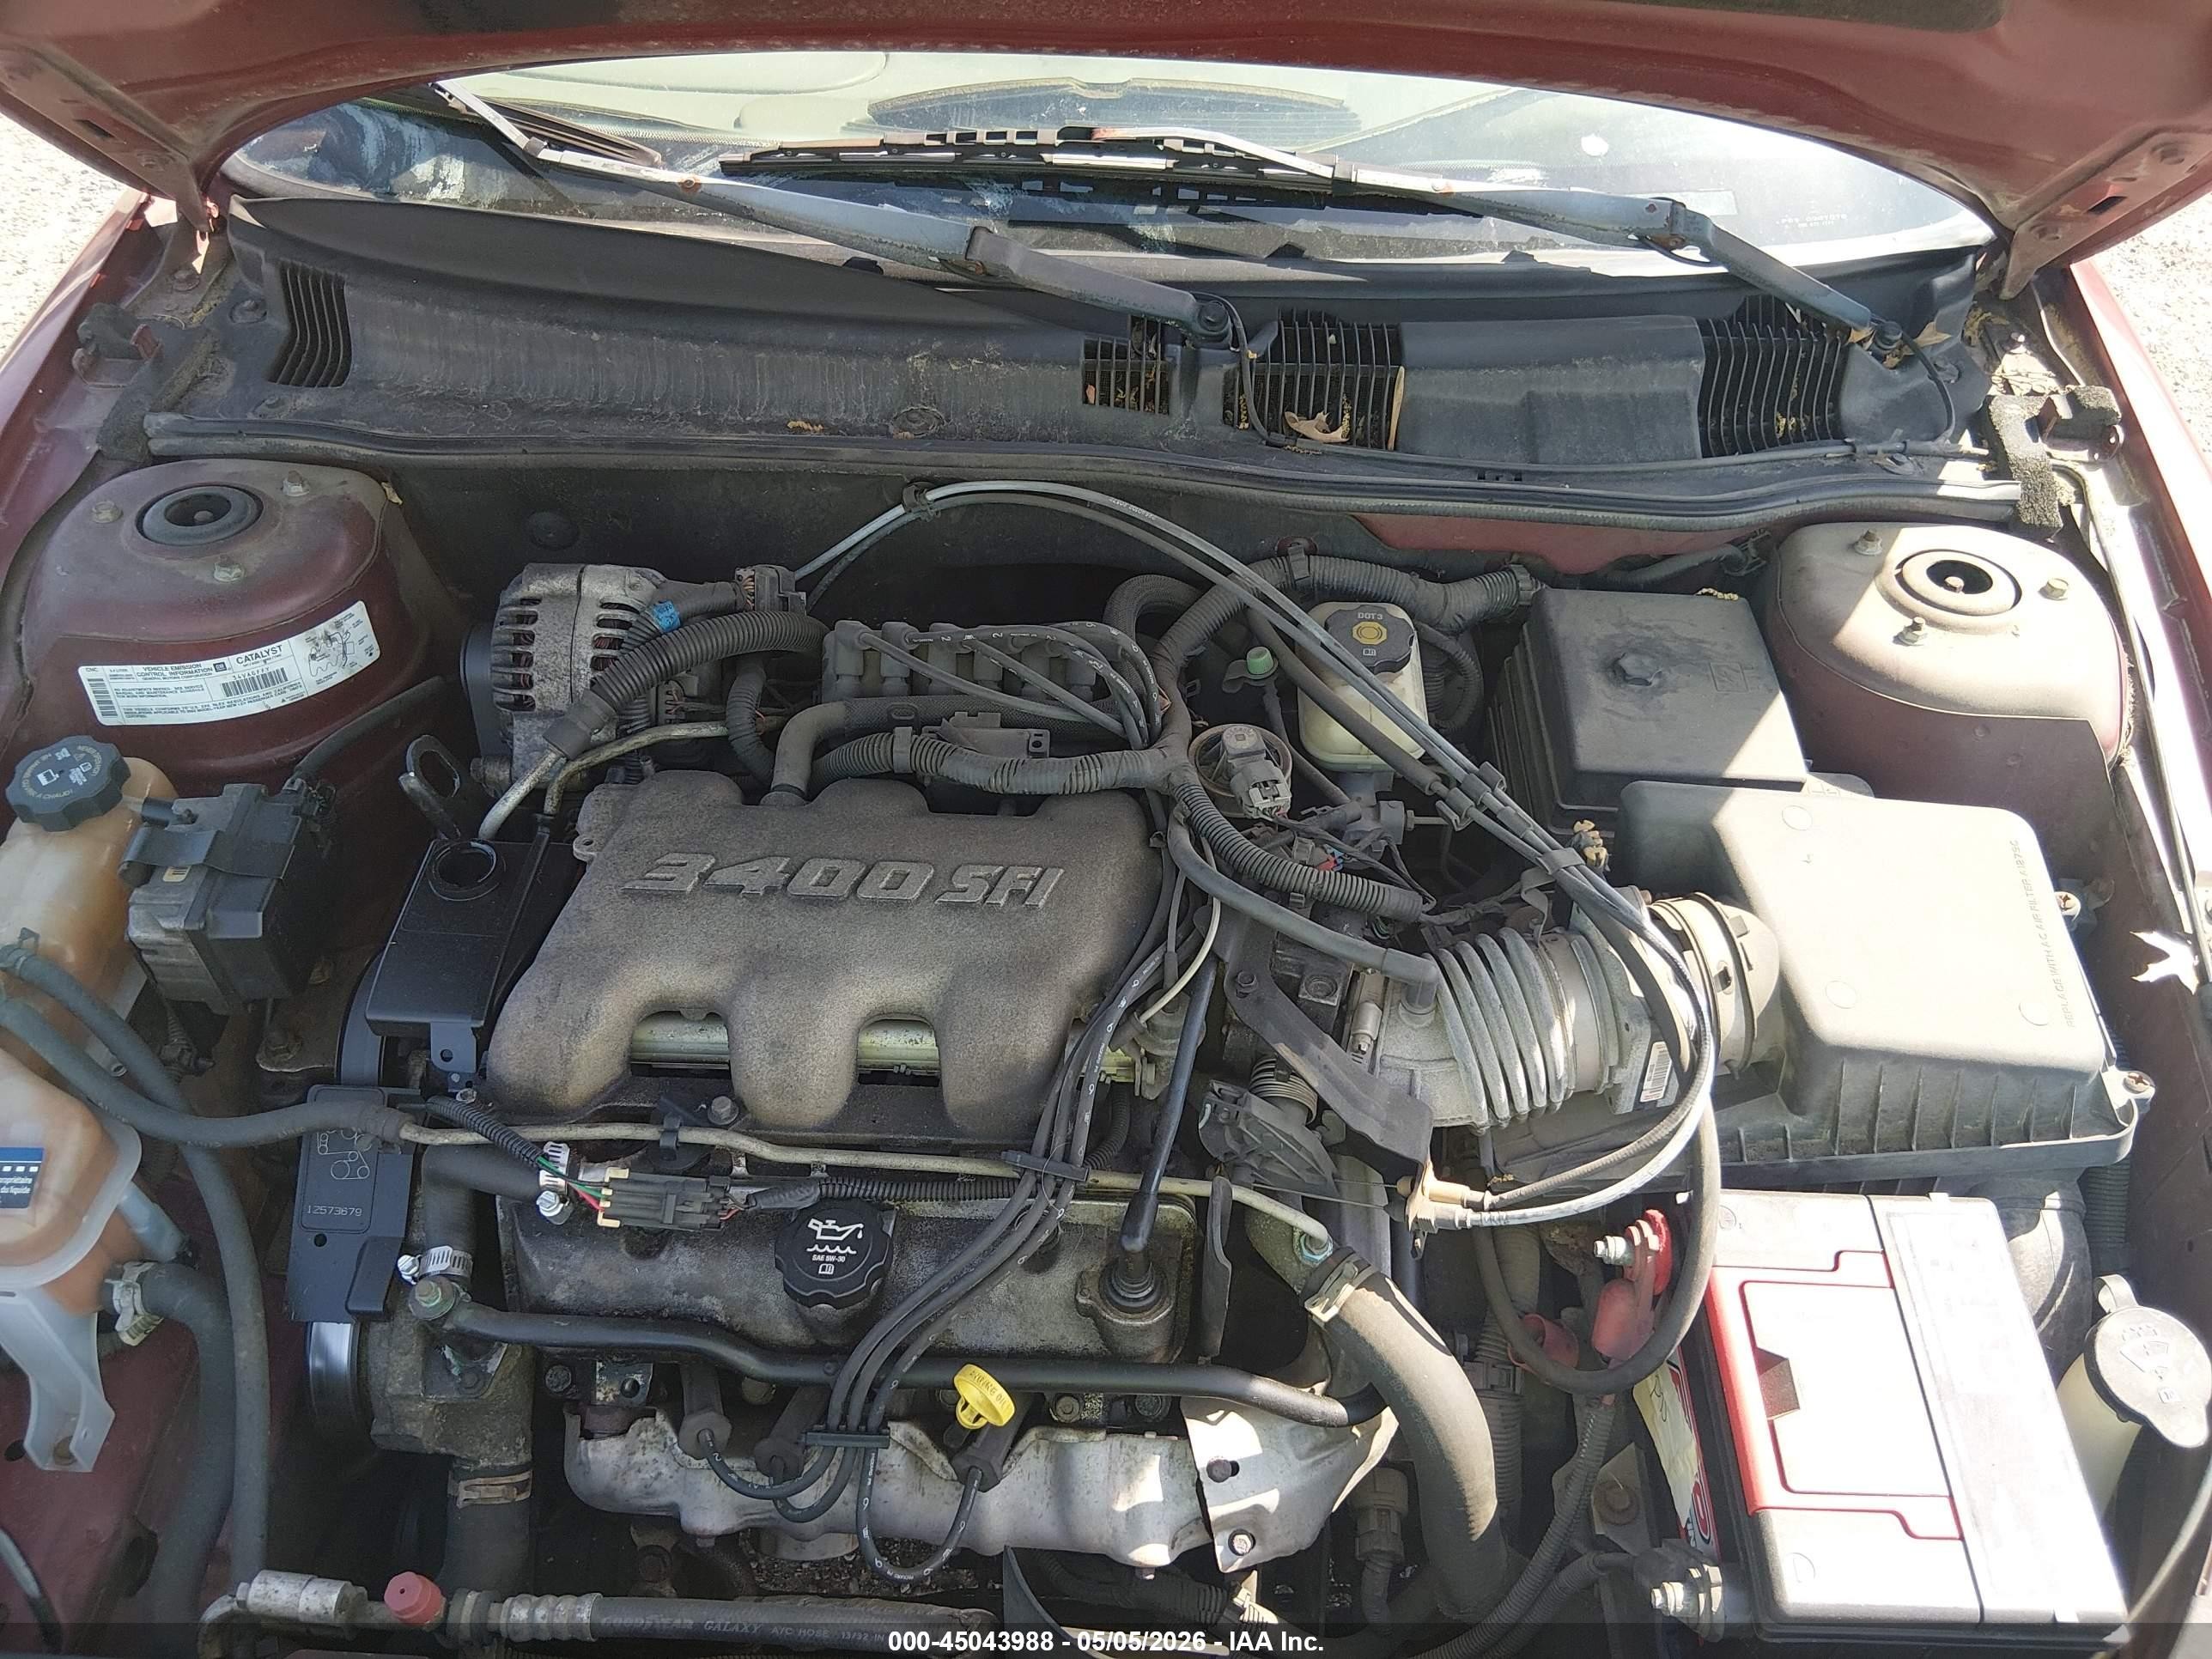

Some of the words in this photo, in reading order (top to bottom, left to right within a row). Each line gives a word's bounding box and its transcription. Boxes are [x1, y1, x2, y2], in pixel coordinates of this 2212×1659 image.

[236, 645, 283, 665] CATALYST
[169, 667, 215, 677] INFORMATION
[620, 852, 935, 902] 3400
[934, 863, 1066, 908] SFI
[307, 1205, 362, 1217] 12573679
[825, 1255, 846, 1263] 5W-30
[703, 1620, 763, 1634] GALAXY
[771, 1626, 794, 1636] A/C
[797, 1627, 830, 1638] HOSE
